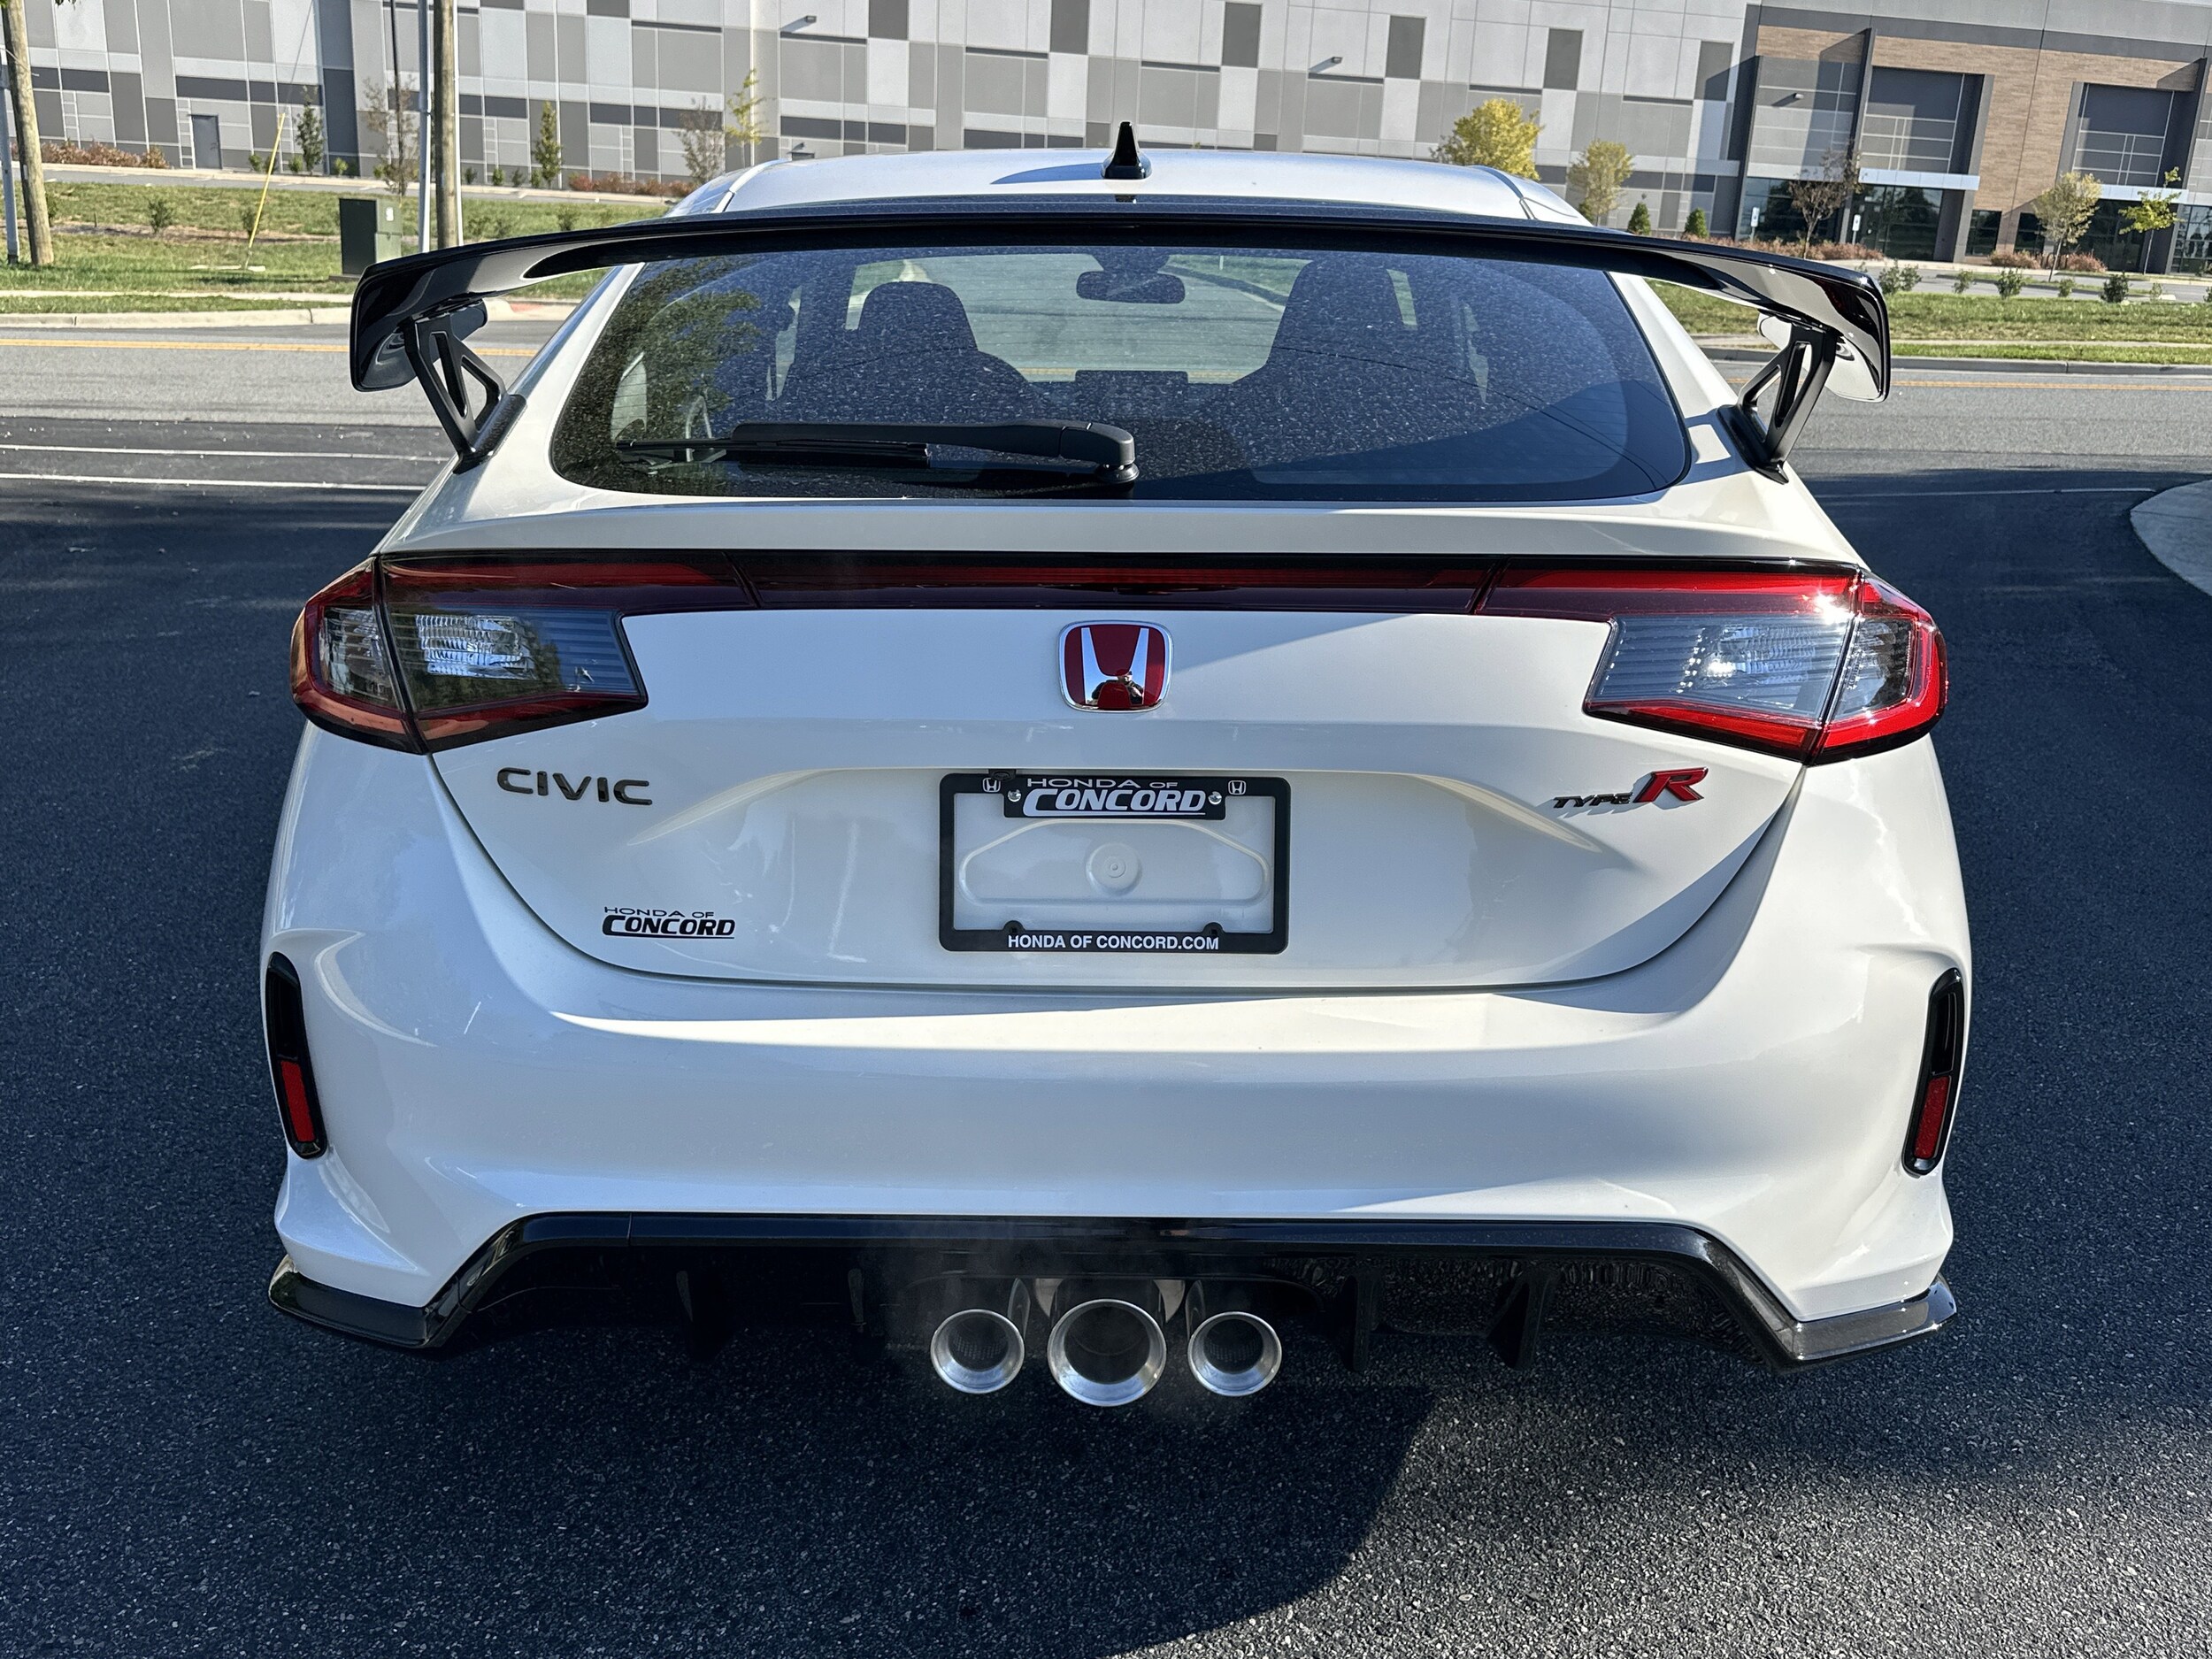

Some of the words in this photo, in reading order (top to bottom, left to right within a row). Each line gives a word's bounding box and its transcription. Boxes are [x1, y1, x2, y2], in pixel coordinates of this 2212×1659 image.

[496, 766, 653, 806] CIVIC
[1026, 778, 1141, 788] HONDA
[1553, 791, 1633, 809] TYPE
[1632, 766, 1709, 803] R
[1023, 787, 1206, 817] CONCORD
[604, 906, 686, 918] HONDA
[602, 914, 735, 939] CONCORD
[1008, 935, 1066, 949] HONDA
[1070, 935, 1093, 949] OF
[1096, 935, 1219, 950] CONCORD.COM
